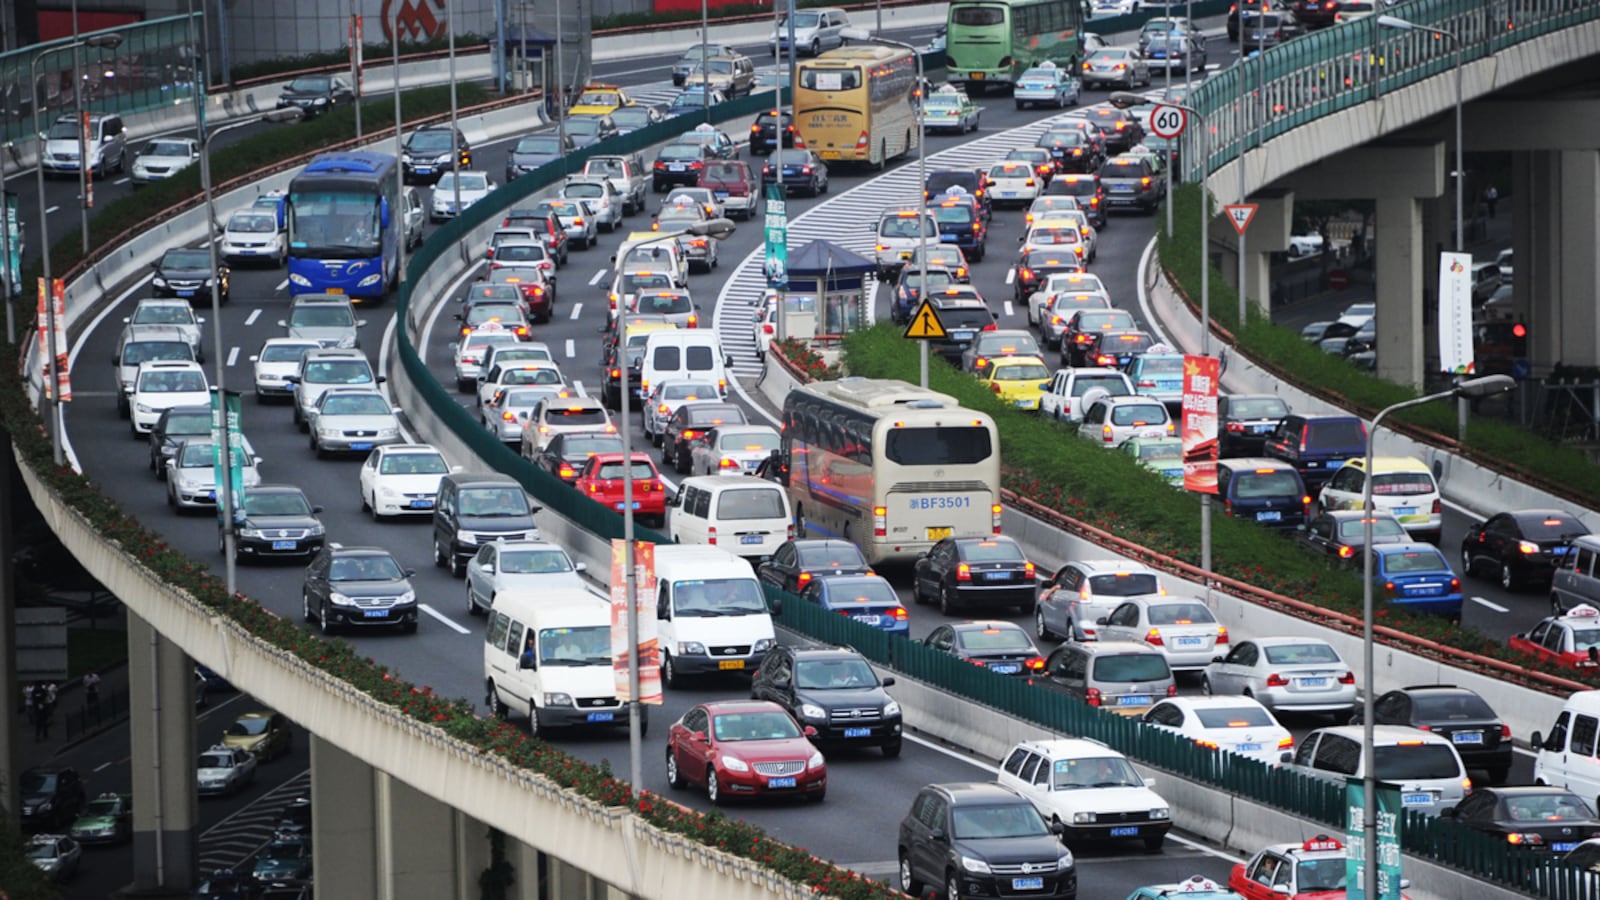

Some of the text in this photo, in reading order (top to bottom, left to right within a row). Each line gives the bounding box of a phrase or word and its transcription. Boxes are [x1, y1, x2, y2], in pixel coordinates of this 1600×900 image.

[1157, 111, 1179, 129] 60
[1234, 208, 1245, 221] 让
[1185, 882, 1213, 891] 大众
